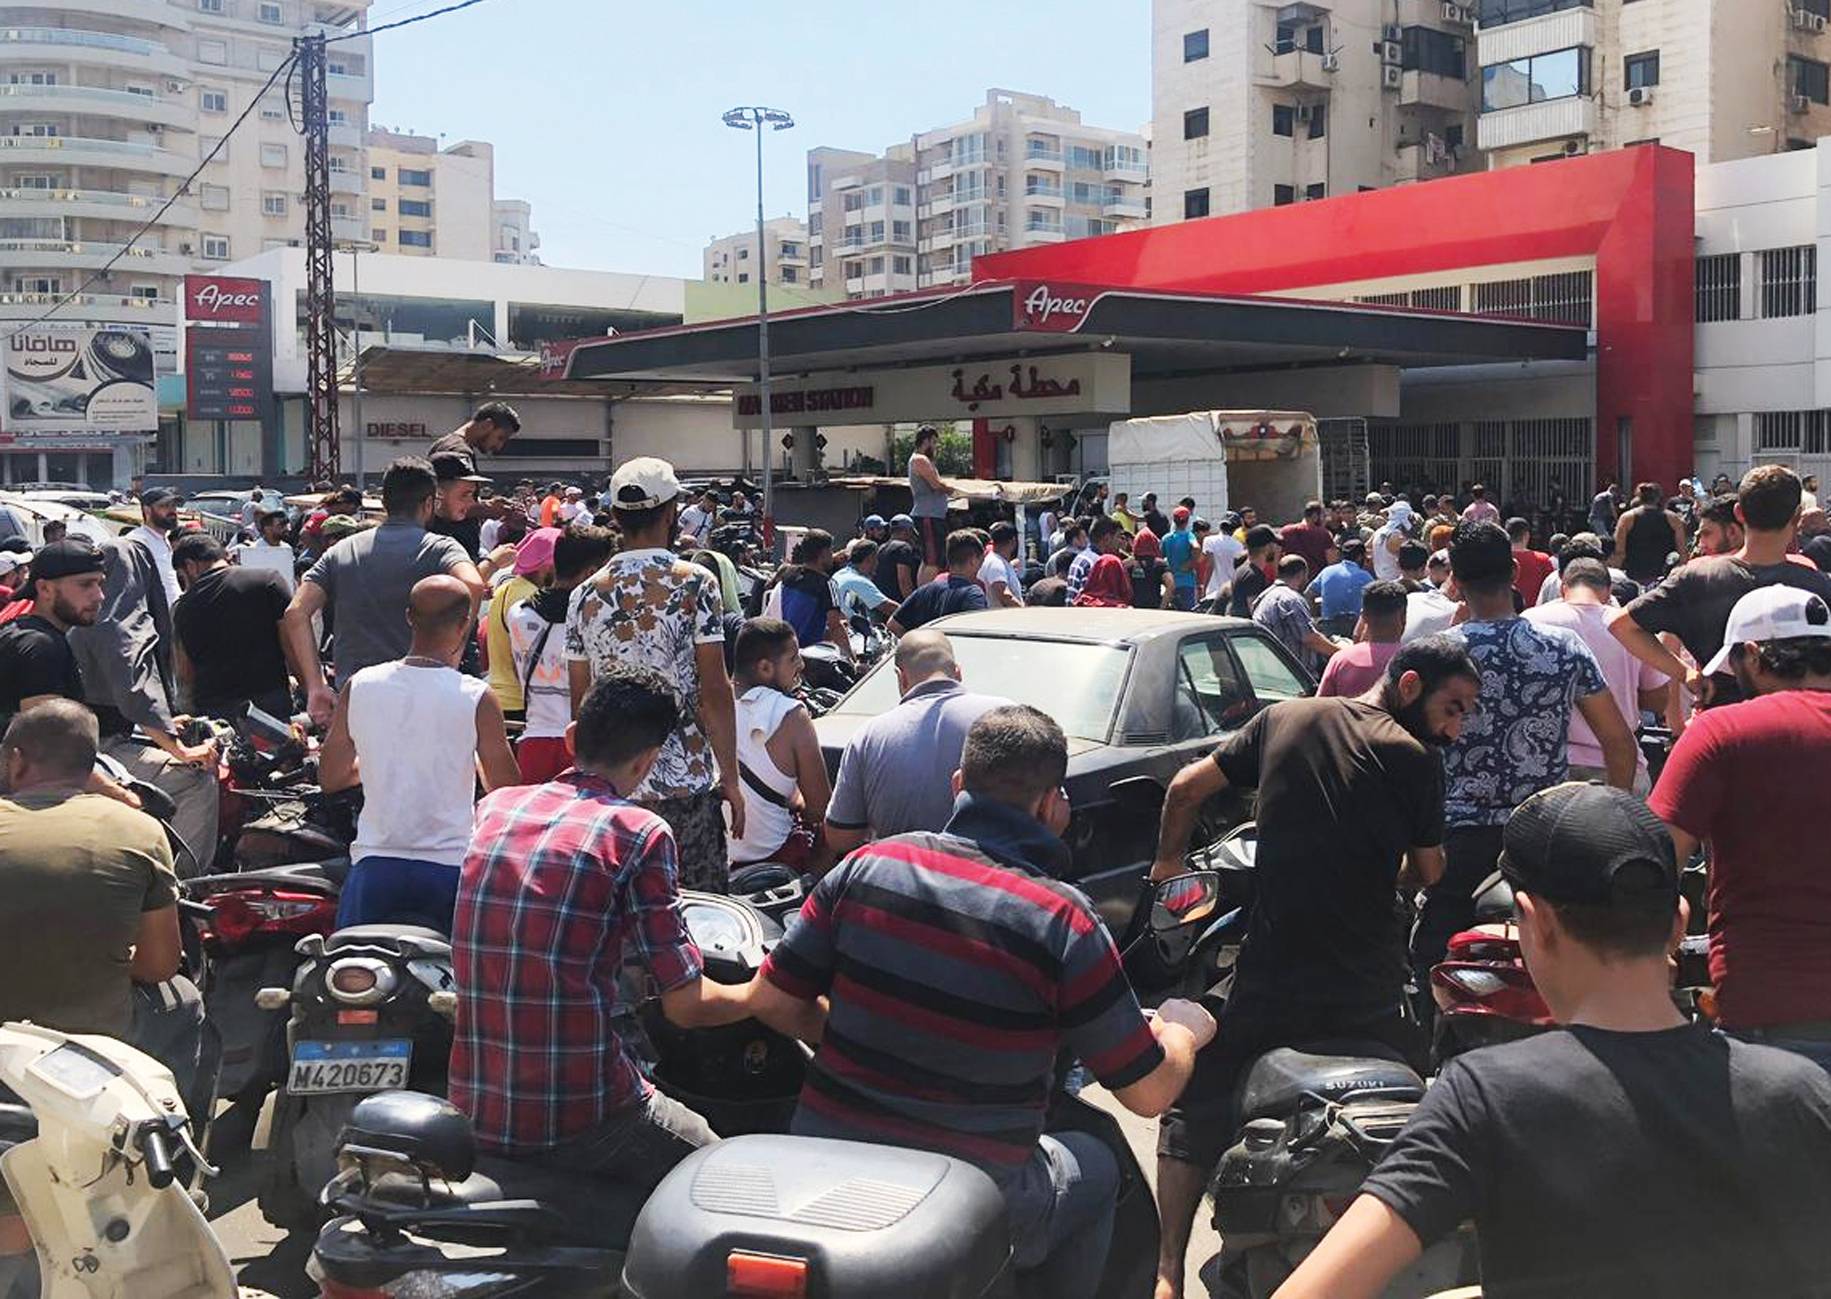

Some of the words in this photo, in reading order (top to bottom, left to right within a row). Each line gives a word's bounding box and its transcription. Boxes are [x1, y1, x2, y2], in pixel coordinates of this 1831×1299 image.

[194, 284, 259, 313] Apec
[1025, 285, 1086, 323] Apec
[1008, 364, 1081, 399] محطة
[806, 387, 873, 411] STATION
[367, 423, 432, 437] DIESEL
[293, 1063, 405, 1089] M420673
[1325, 1080, 1384, 1089] SUZUKI
